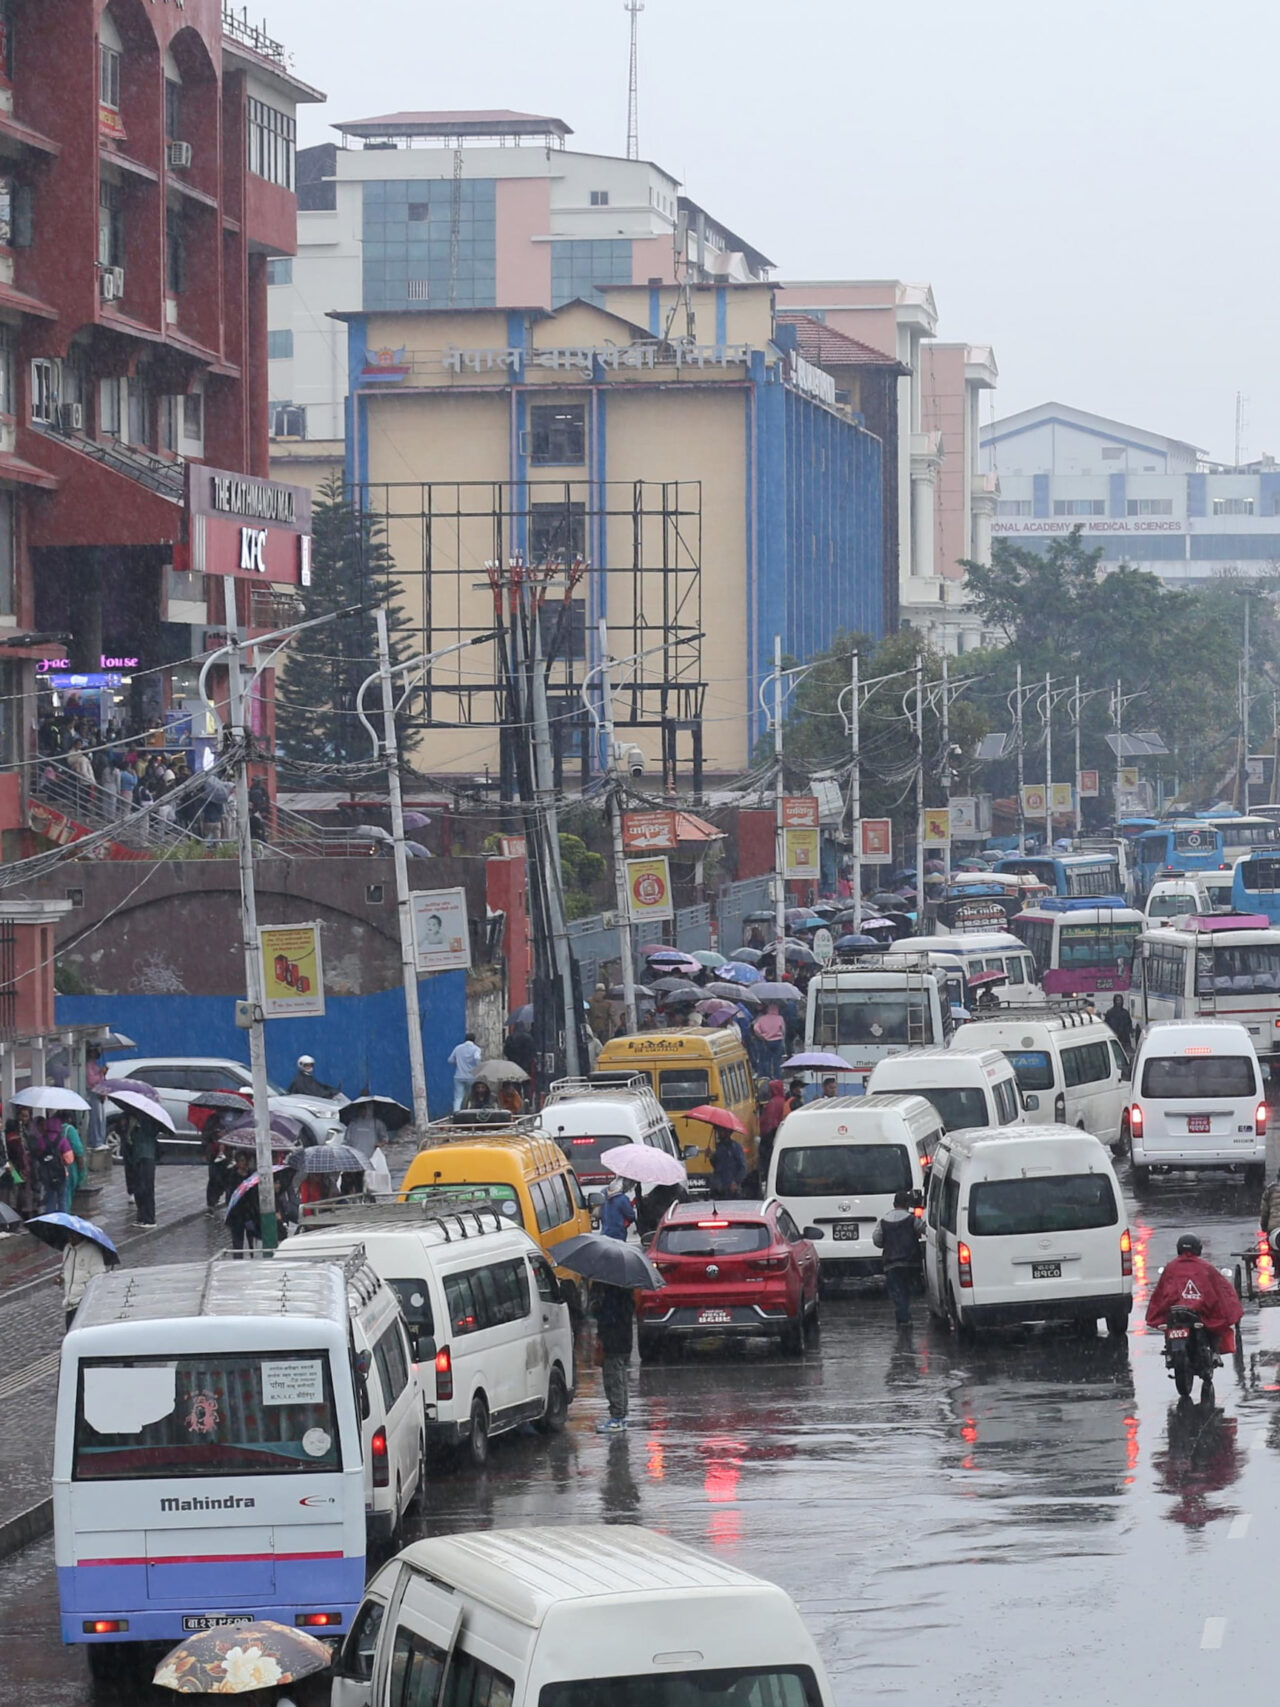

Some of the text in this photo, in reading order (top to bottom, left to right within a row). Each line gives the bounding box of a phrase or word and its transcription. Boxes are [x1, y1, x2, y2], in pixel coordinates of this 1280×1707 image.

[442, 342, 522, 373] नेपाल
[211, 477, 231, 511] THE
[231, 480, 276, 520] KATHMANDU
[1023, 522, 1071, 532] ACADEMY
[1089, 521, 1131, 531] MEDICAL
[1134, 521, 1182, 531] SCIENCES
[240, 527, 267, 572] KFC
[160, 1495, 255, 1512] Mahindra
